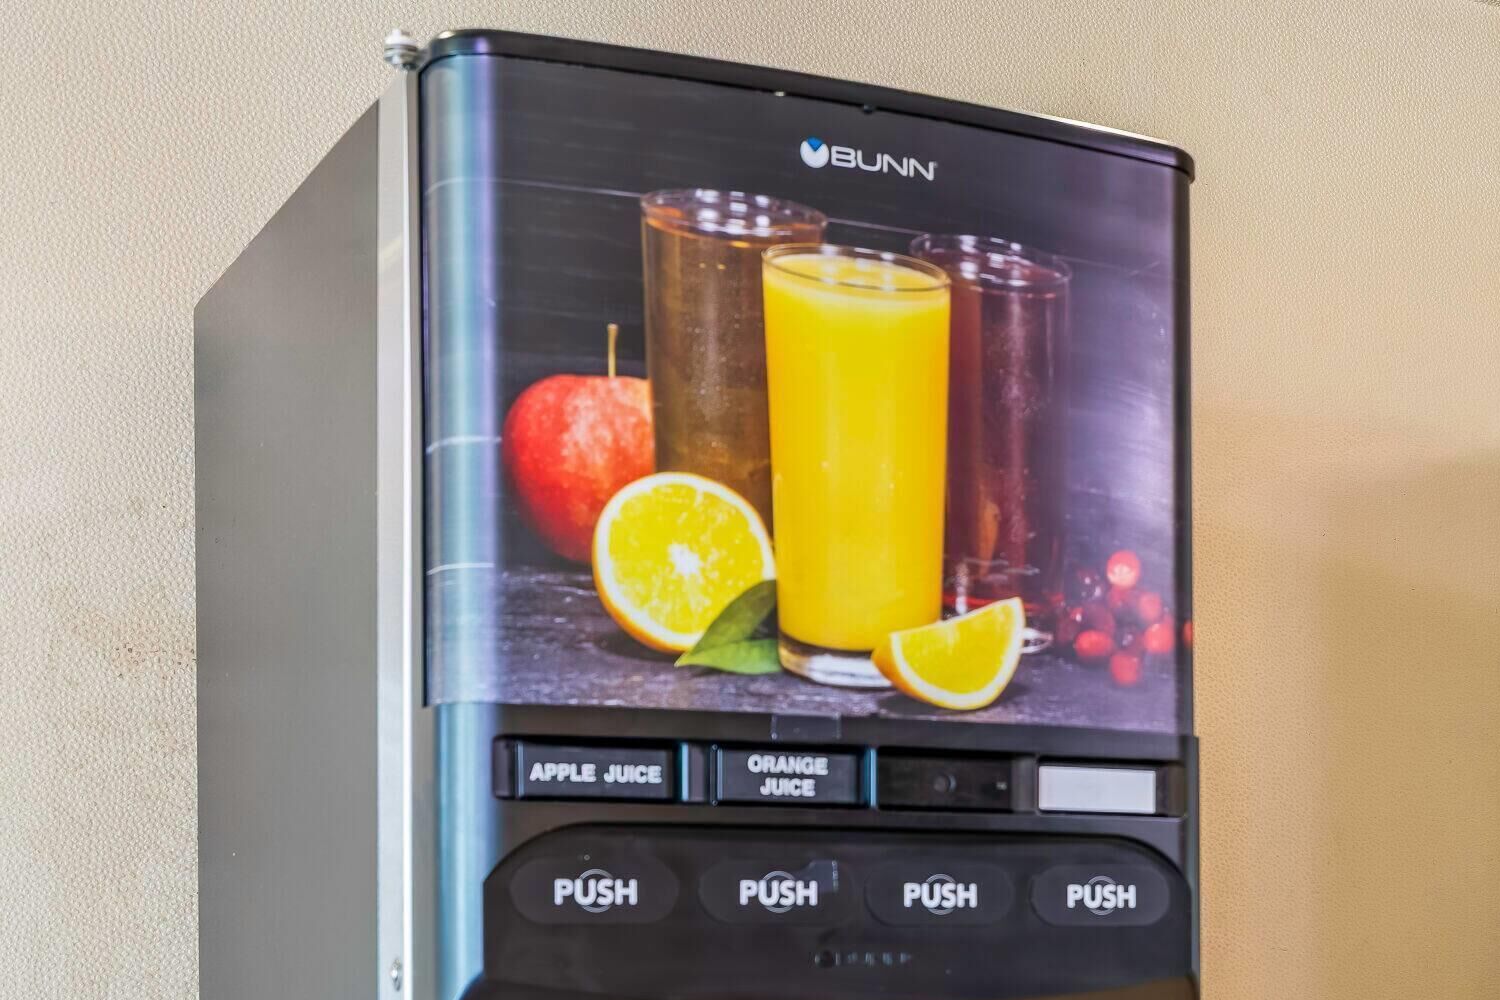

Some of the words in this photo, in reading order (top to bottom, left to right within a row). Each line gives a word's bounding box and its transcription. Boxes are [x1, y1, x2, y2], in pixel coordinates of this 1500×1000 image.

[831, 146, 935, 181] BUNN
[529, 762, 596, 784] APPLE
[603, 764, 662, 785] JUICE
[747, 753, 829, 776] ORANGE
[759, 777, 816, 797] JUICE
[554, 876, 638, 906] PUSH
[739, 879, 818, 907] PUSH
[903, 881, 978, 909] PUSH
[1067, 883, 1137, 910] PUSH
